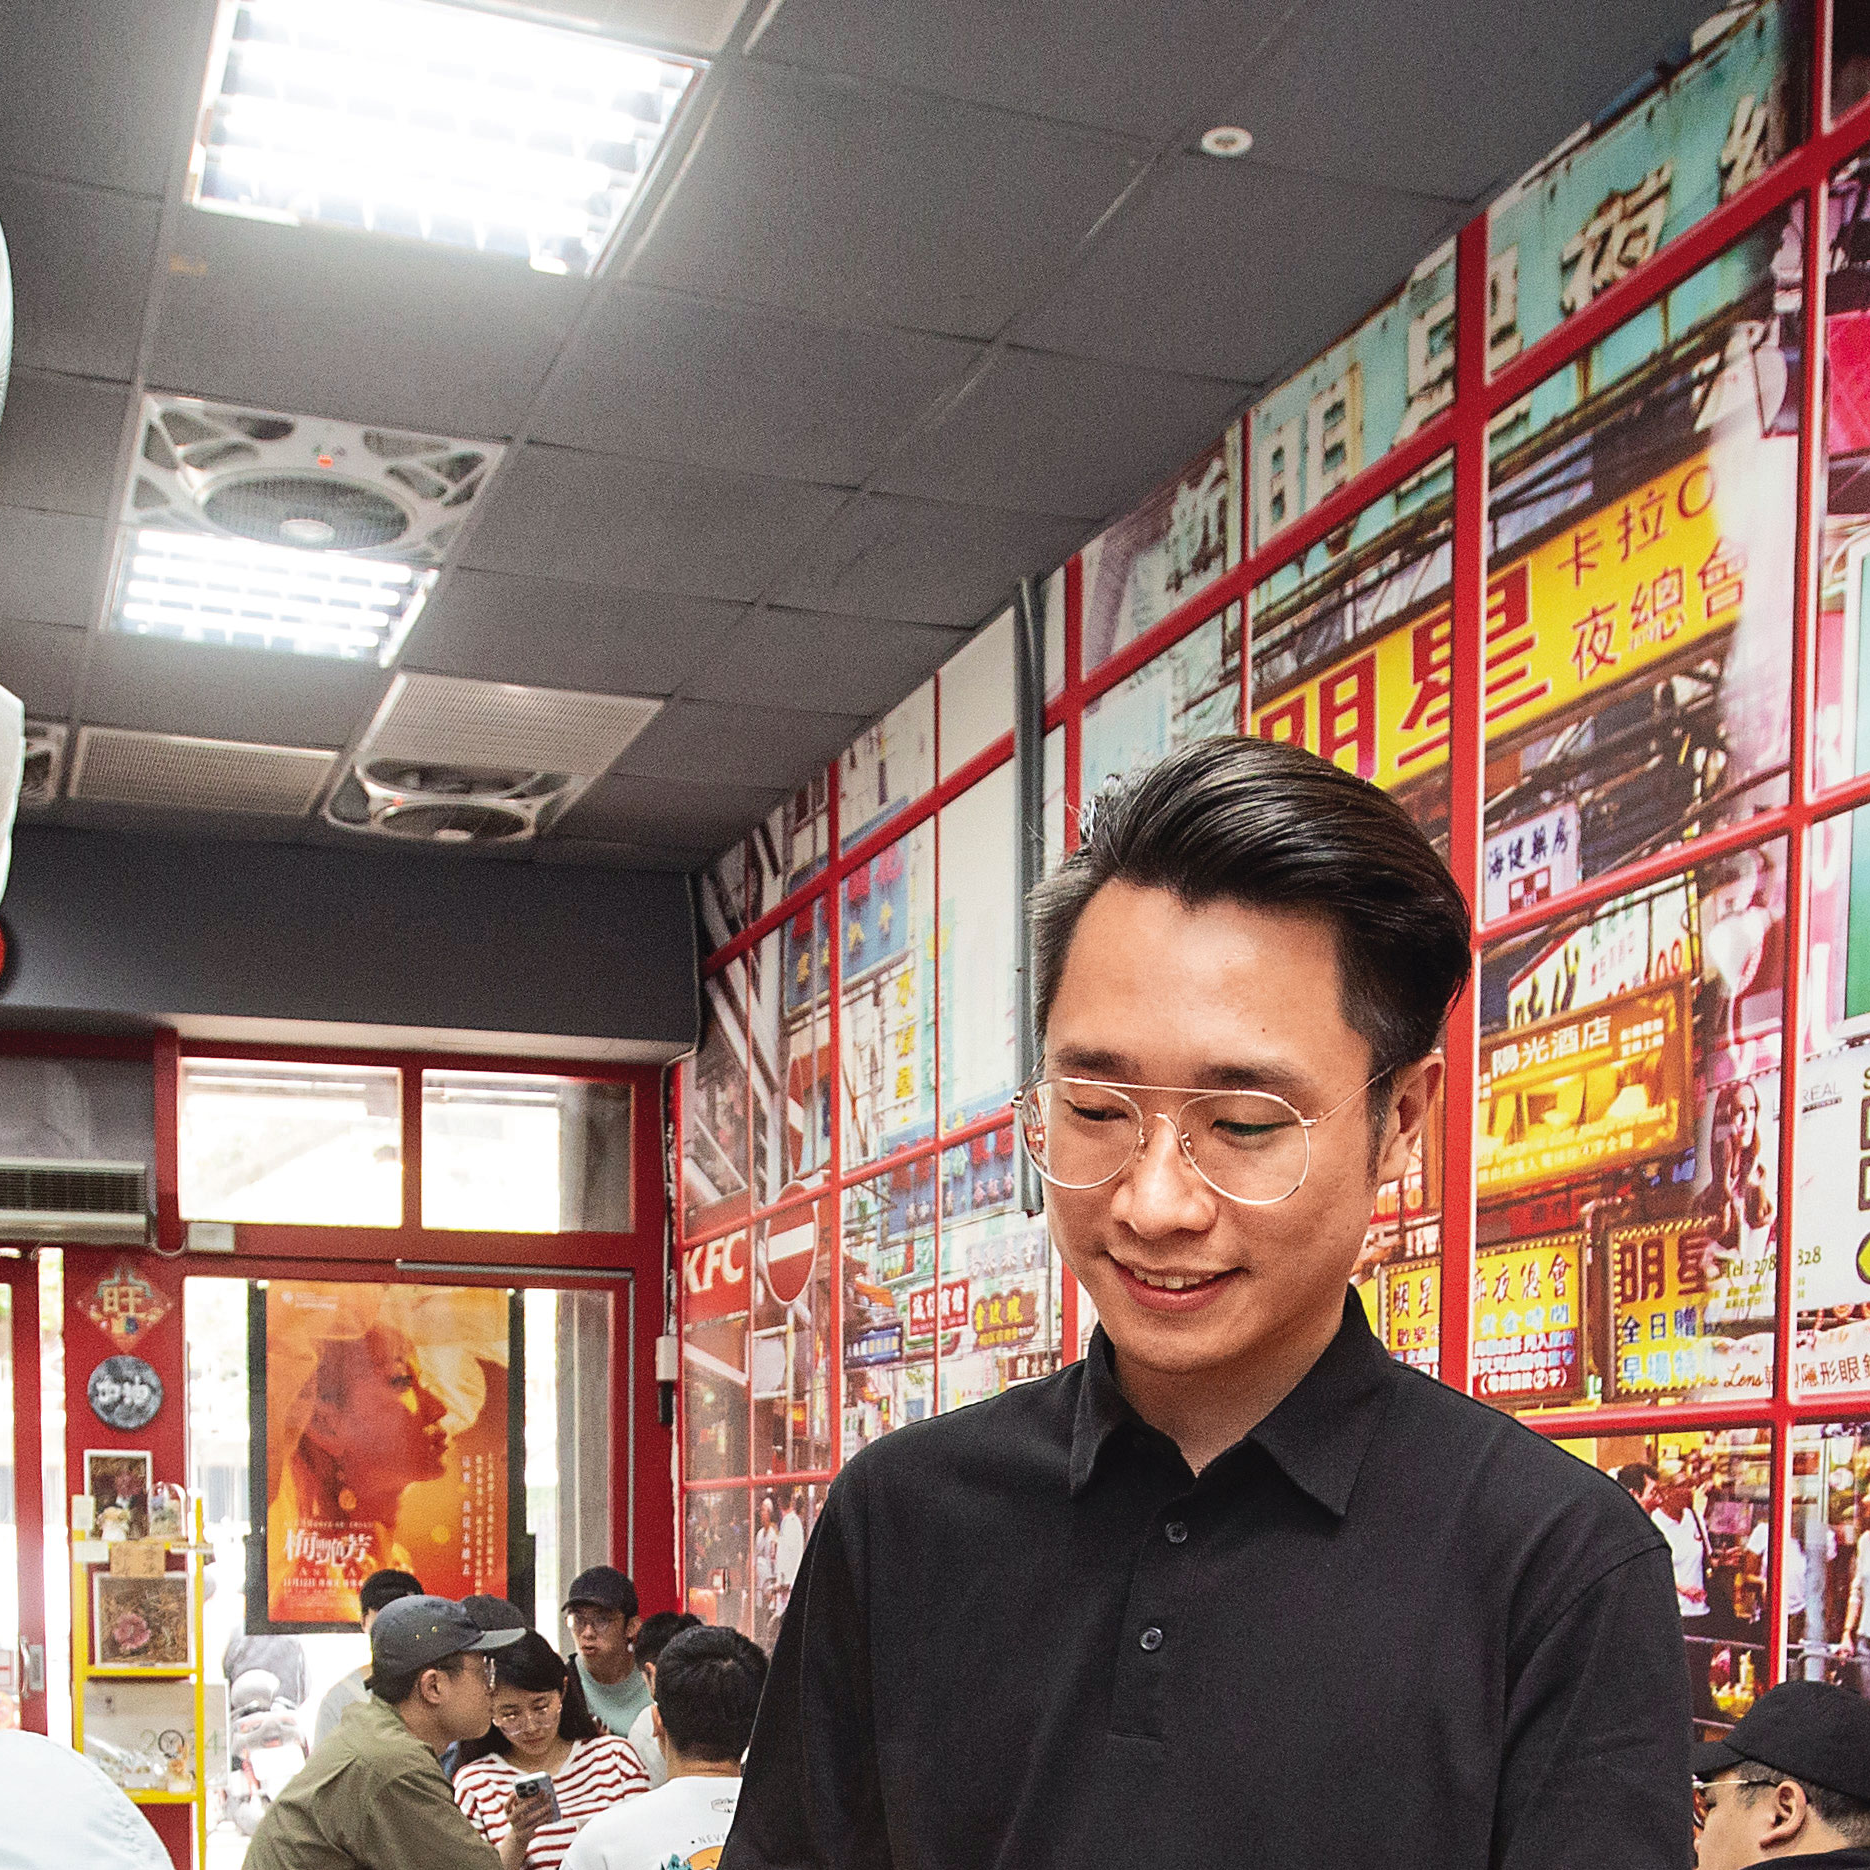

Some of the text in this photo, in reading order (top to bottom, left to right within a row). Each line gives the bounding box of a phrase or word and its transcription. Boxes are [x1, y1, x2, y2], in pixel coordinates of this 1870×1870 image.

[1571, 536, 1749, 684] 夜總會
[1492, 1015, 1611, 1078] 陽光酒店
[683, 1231, 746, 1292] KFC
[1724, 1363, 1763, 1388] Lens
